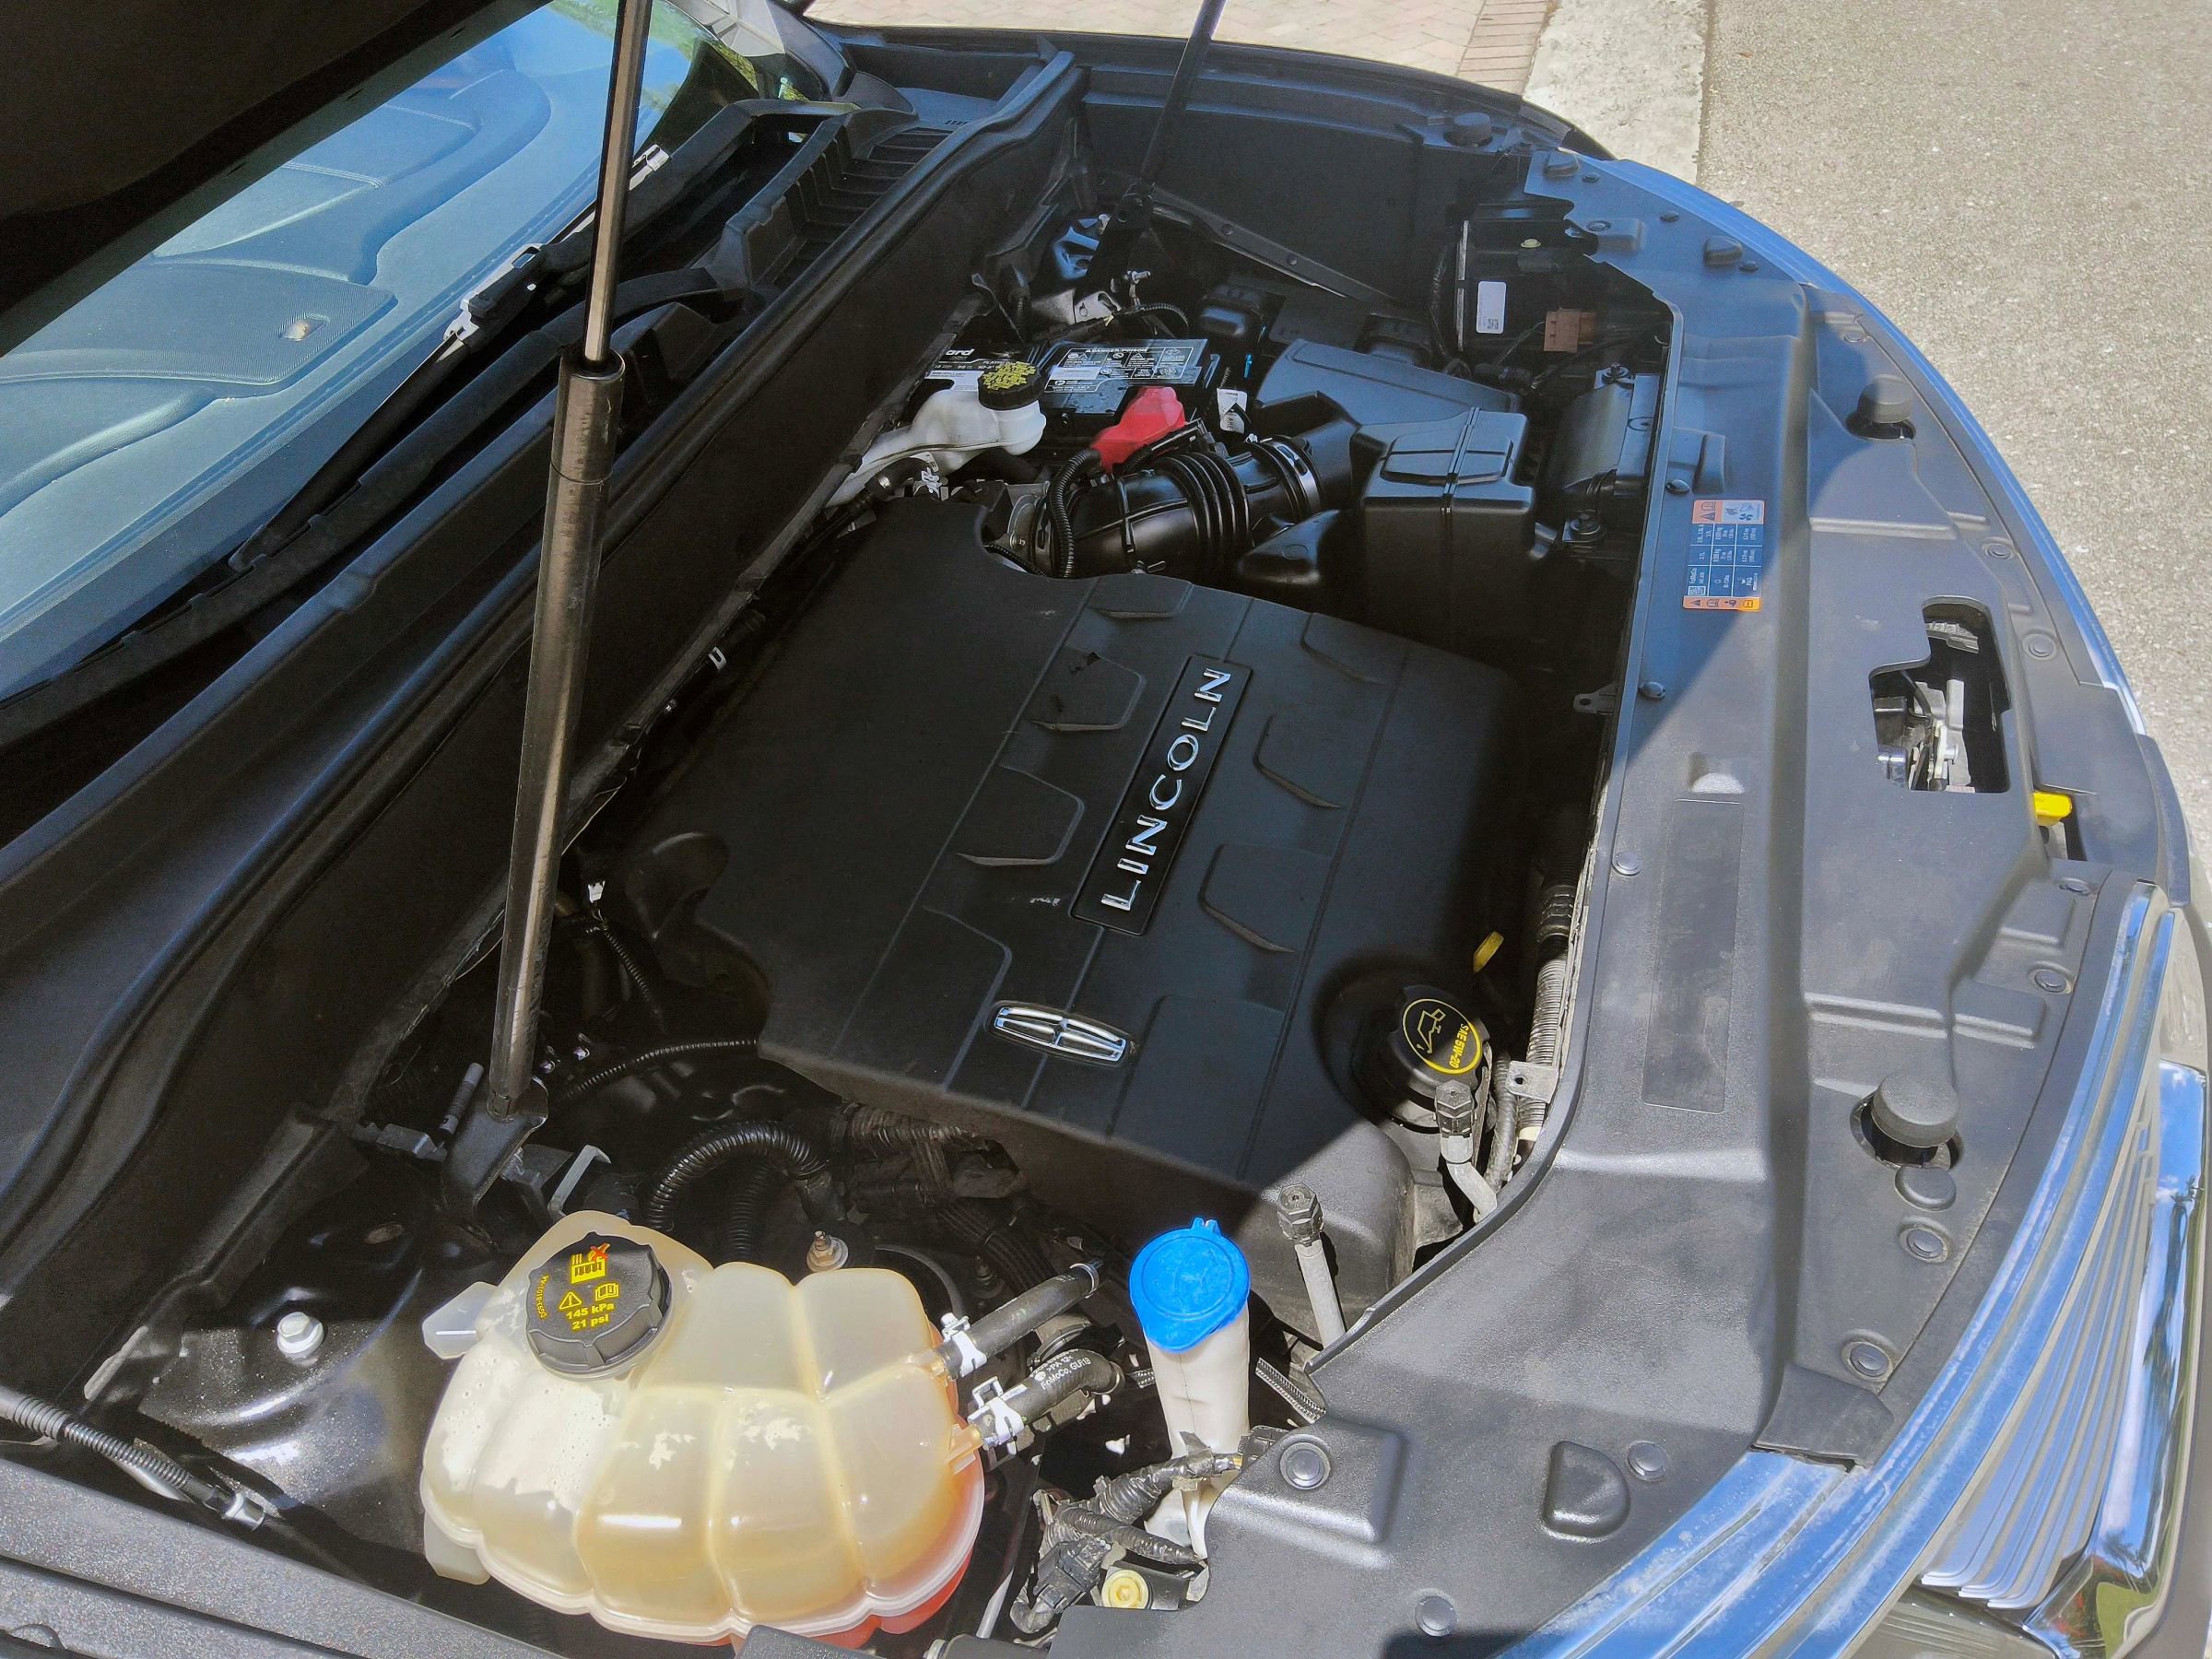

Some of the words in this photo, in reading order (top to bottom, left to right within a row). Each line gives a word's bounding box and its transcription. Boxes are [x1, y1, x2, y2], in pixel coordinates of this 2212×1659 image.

[1100, 666, 1231, 912] LINCOLN
[1456, 1023, 1469, 1042] SAE
[1449, 1040, 1465, 1069] 5W-20
[566, 1308, 589, 1321] 145
[591, 1302, 615, 1315] kPa
[571, 1321, 587, 1331] 21
[590, 1314, 610, 1328] psi
[1041, 1367, 1072, 1391] FoMoCo,
